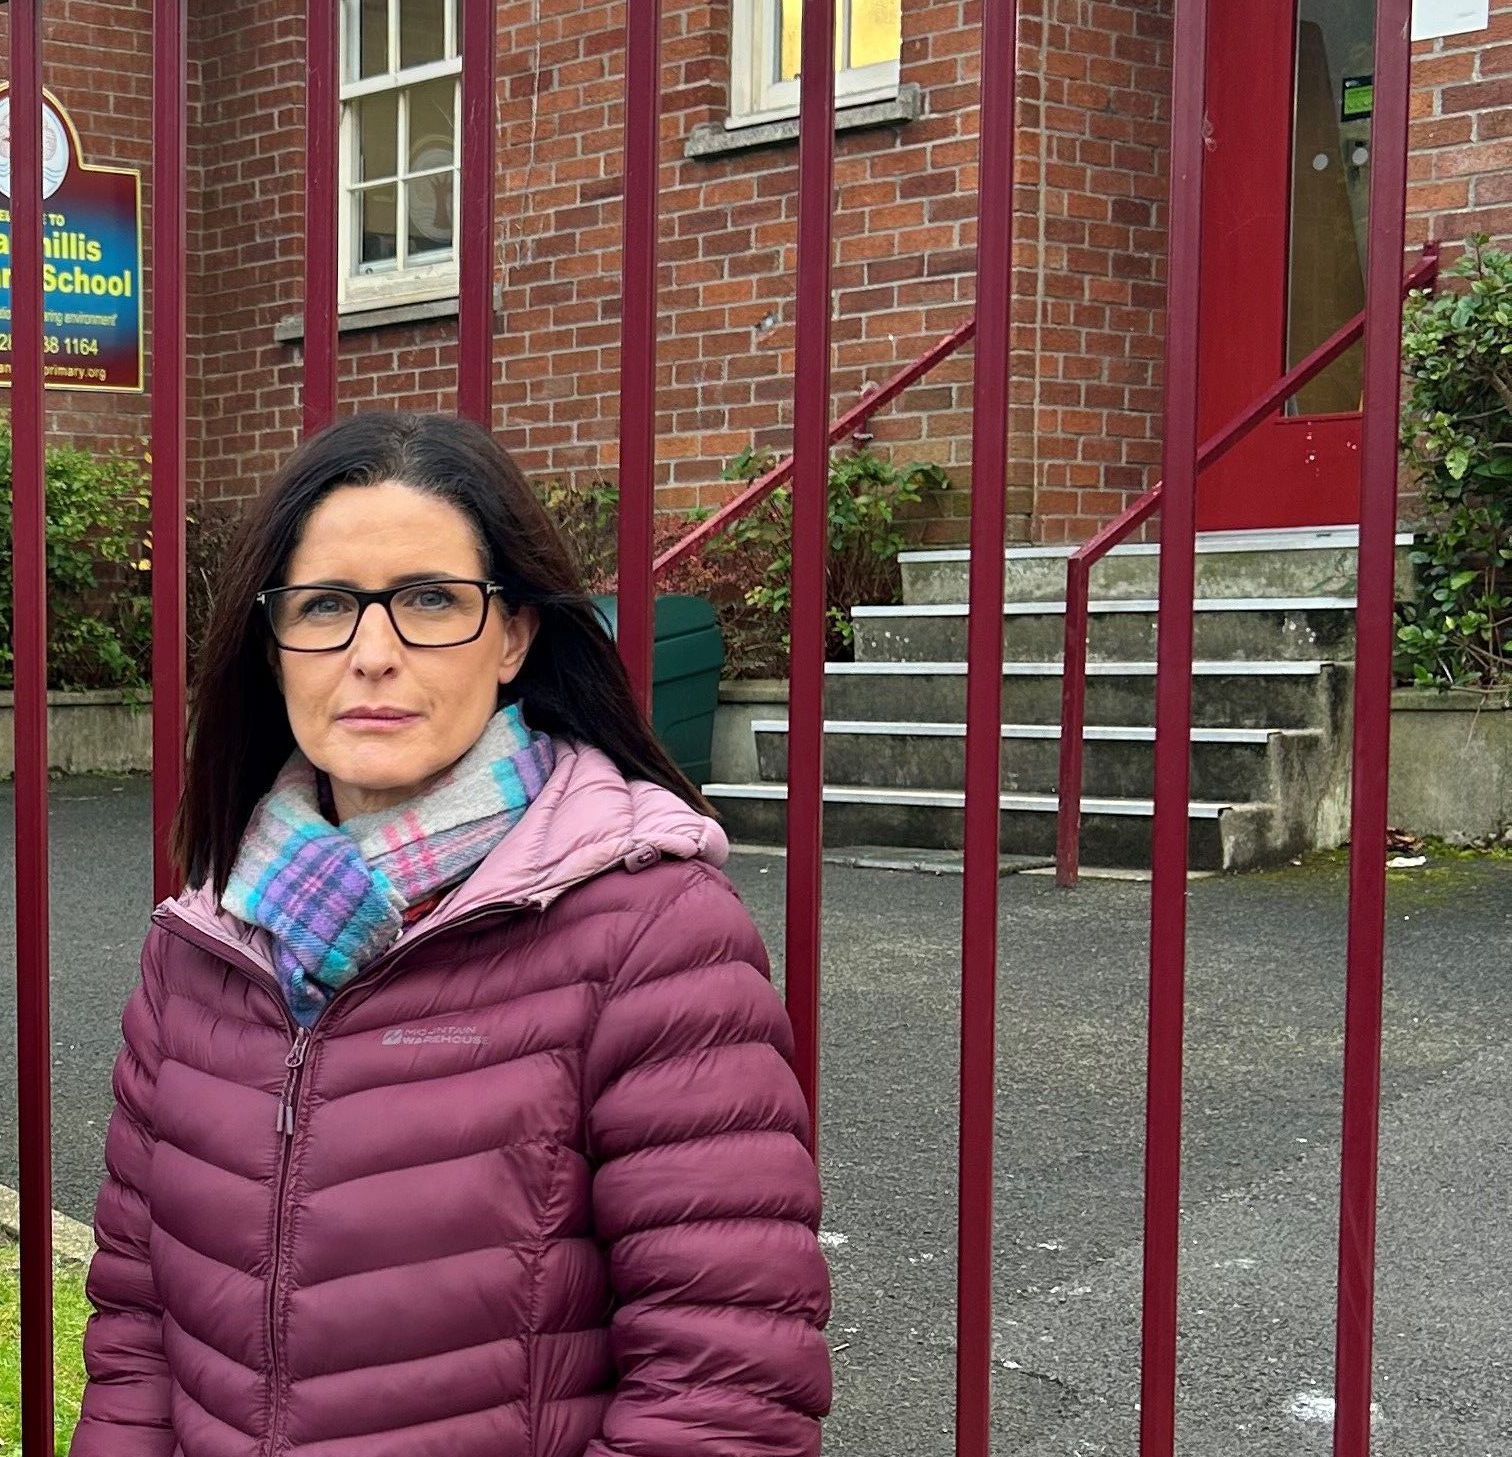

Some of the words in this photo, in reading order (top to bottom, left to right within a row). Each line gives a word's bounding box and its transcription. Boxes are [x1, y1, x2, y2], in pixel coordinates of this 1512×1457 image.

[49, 213, 66, 227] TO
[43, 263, 132, 298] School
[64, 337, 99, 356] 1164
